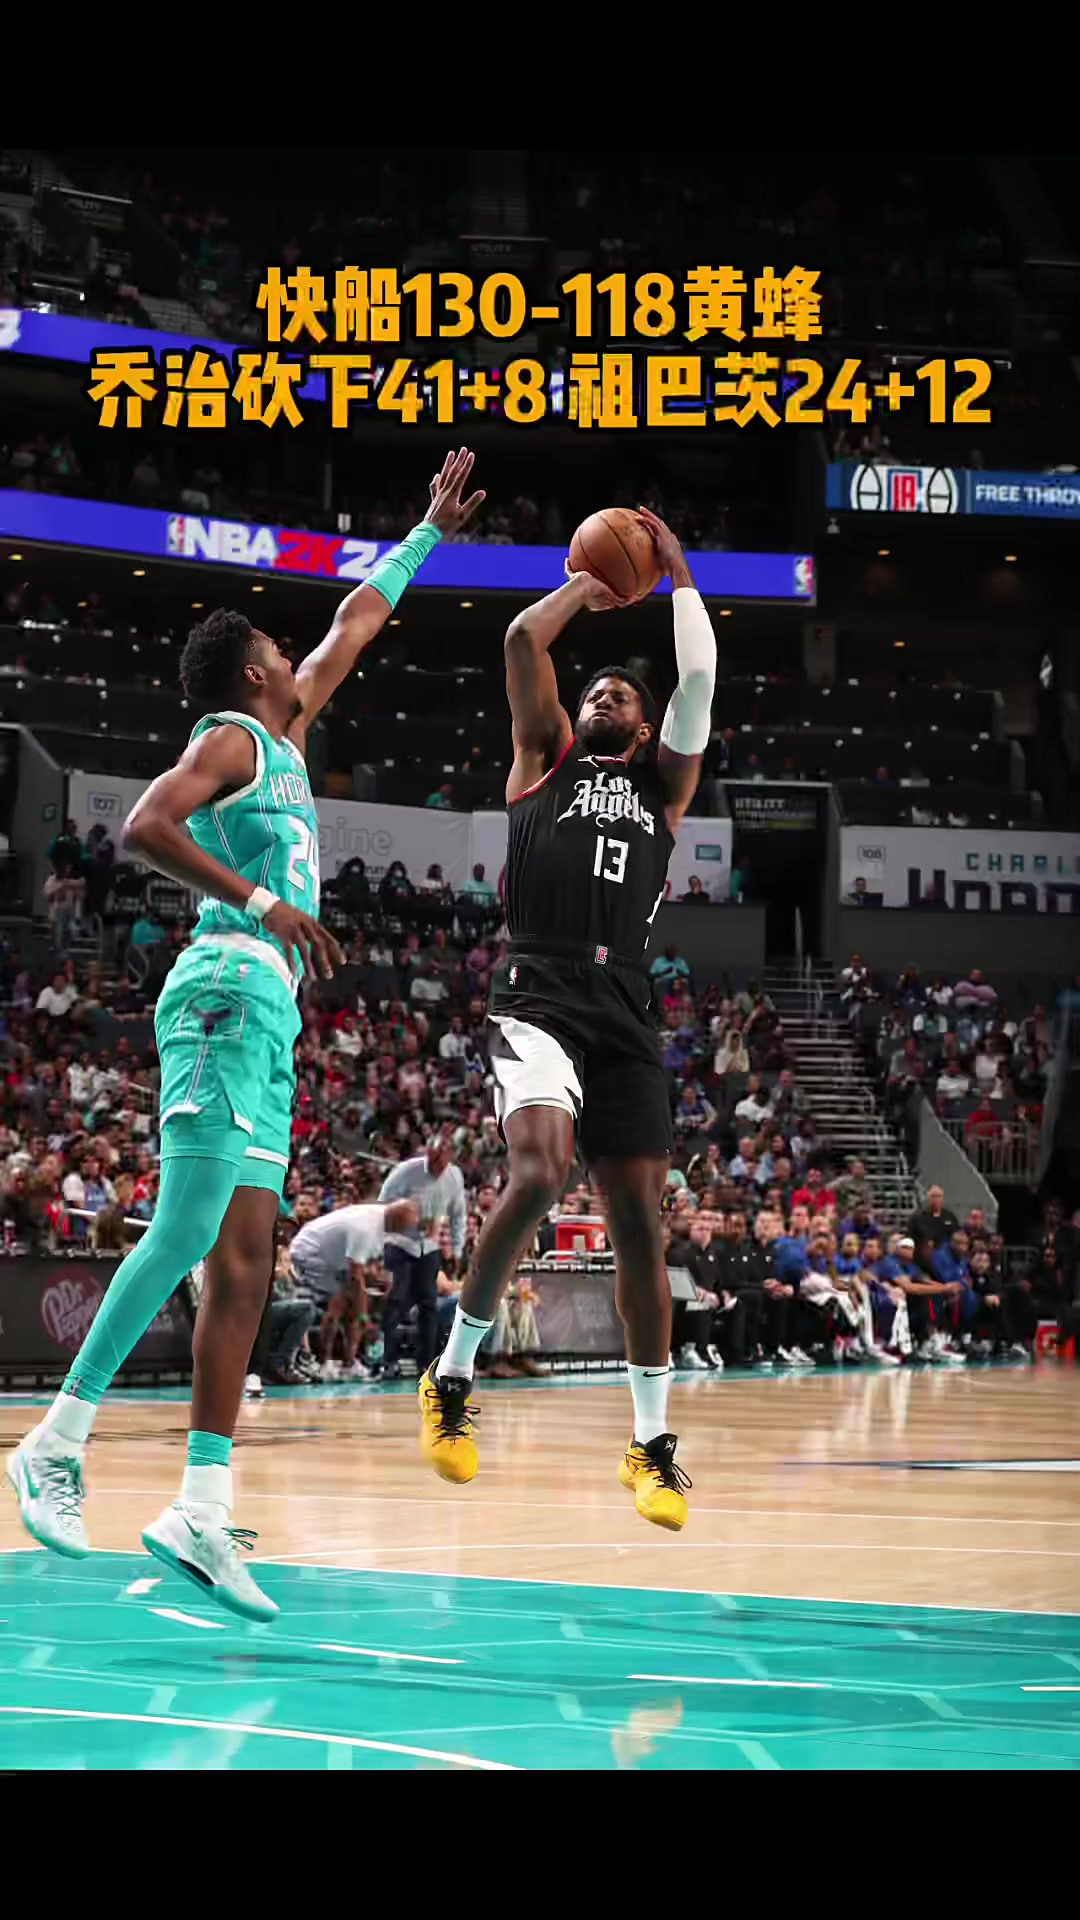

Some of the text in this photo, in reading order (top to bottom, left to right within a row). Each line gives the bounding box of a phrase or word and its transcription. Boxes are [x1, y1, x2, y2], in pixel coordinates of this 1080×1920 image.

[975, 485, 1020, 502] FREE
[557, 780, 655, 835] Angels
[593, 835, 629, 883] 13
